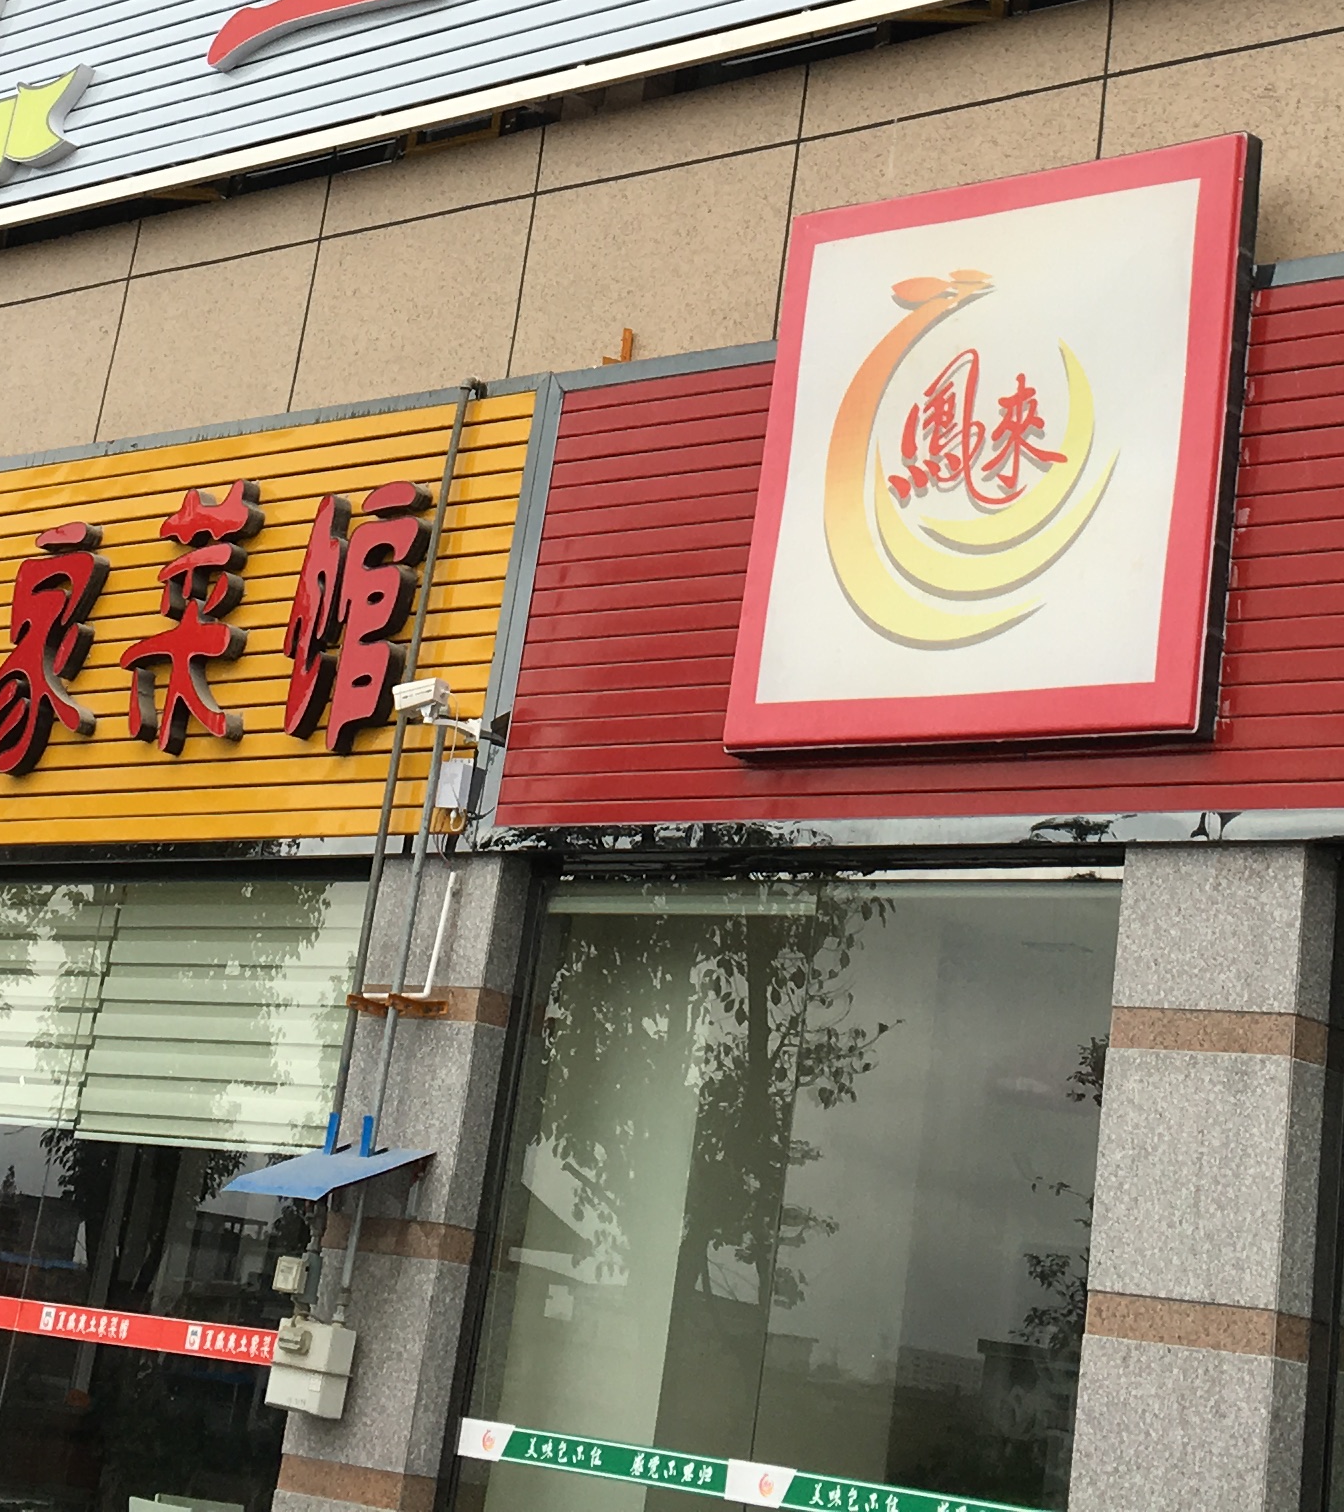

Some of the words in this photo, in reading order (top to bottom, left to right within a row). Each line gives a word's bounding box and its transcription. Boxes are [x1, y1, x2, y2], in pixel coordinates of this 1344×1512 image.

[202, 1329, 276, 1359] 夏威夷土家菜
